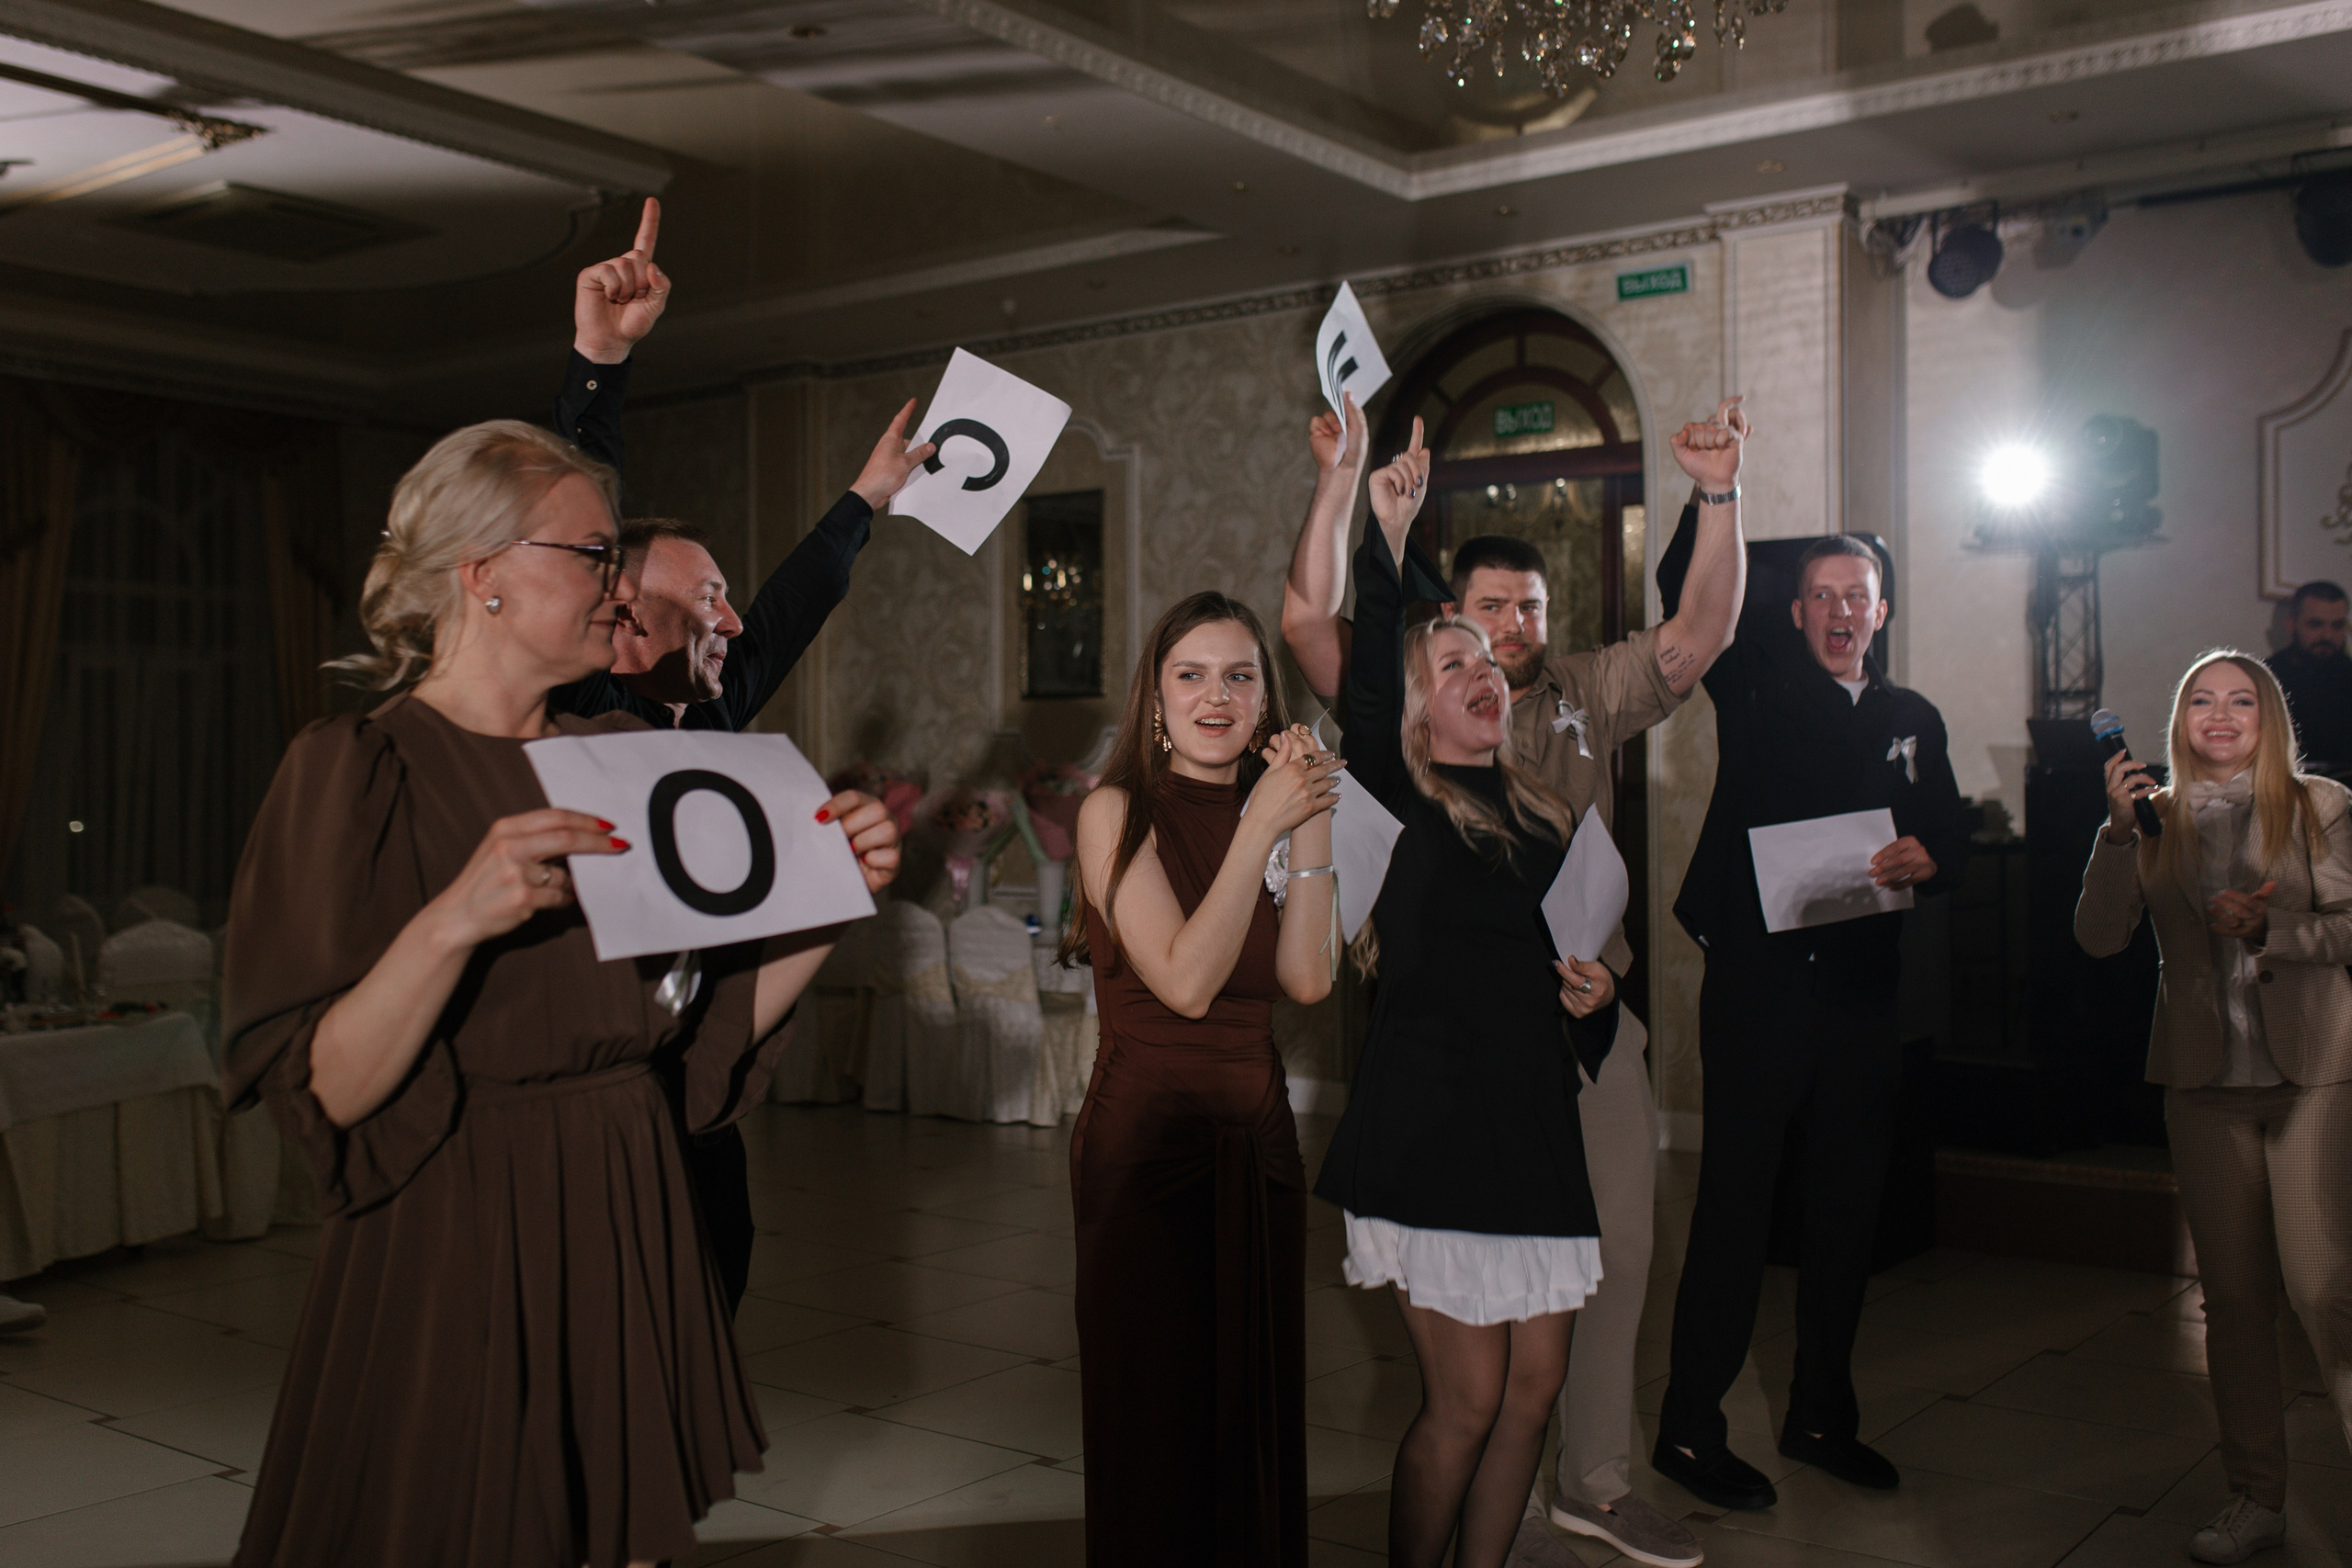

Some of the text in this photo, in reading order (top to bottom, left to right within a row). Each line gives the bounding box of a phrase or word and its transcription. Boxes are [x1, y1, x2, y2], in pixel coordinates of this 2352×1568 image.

[1622, 269, 1682, 295] ВЫХОД
[1495, 403, 1552, 434] ВЫХОД
[923, 418, 1010, 491] C
[649, 769, 776, 917] O
